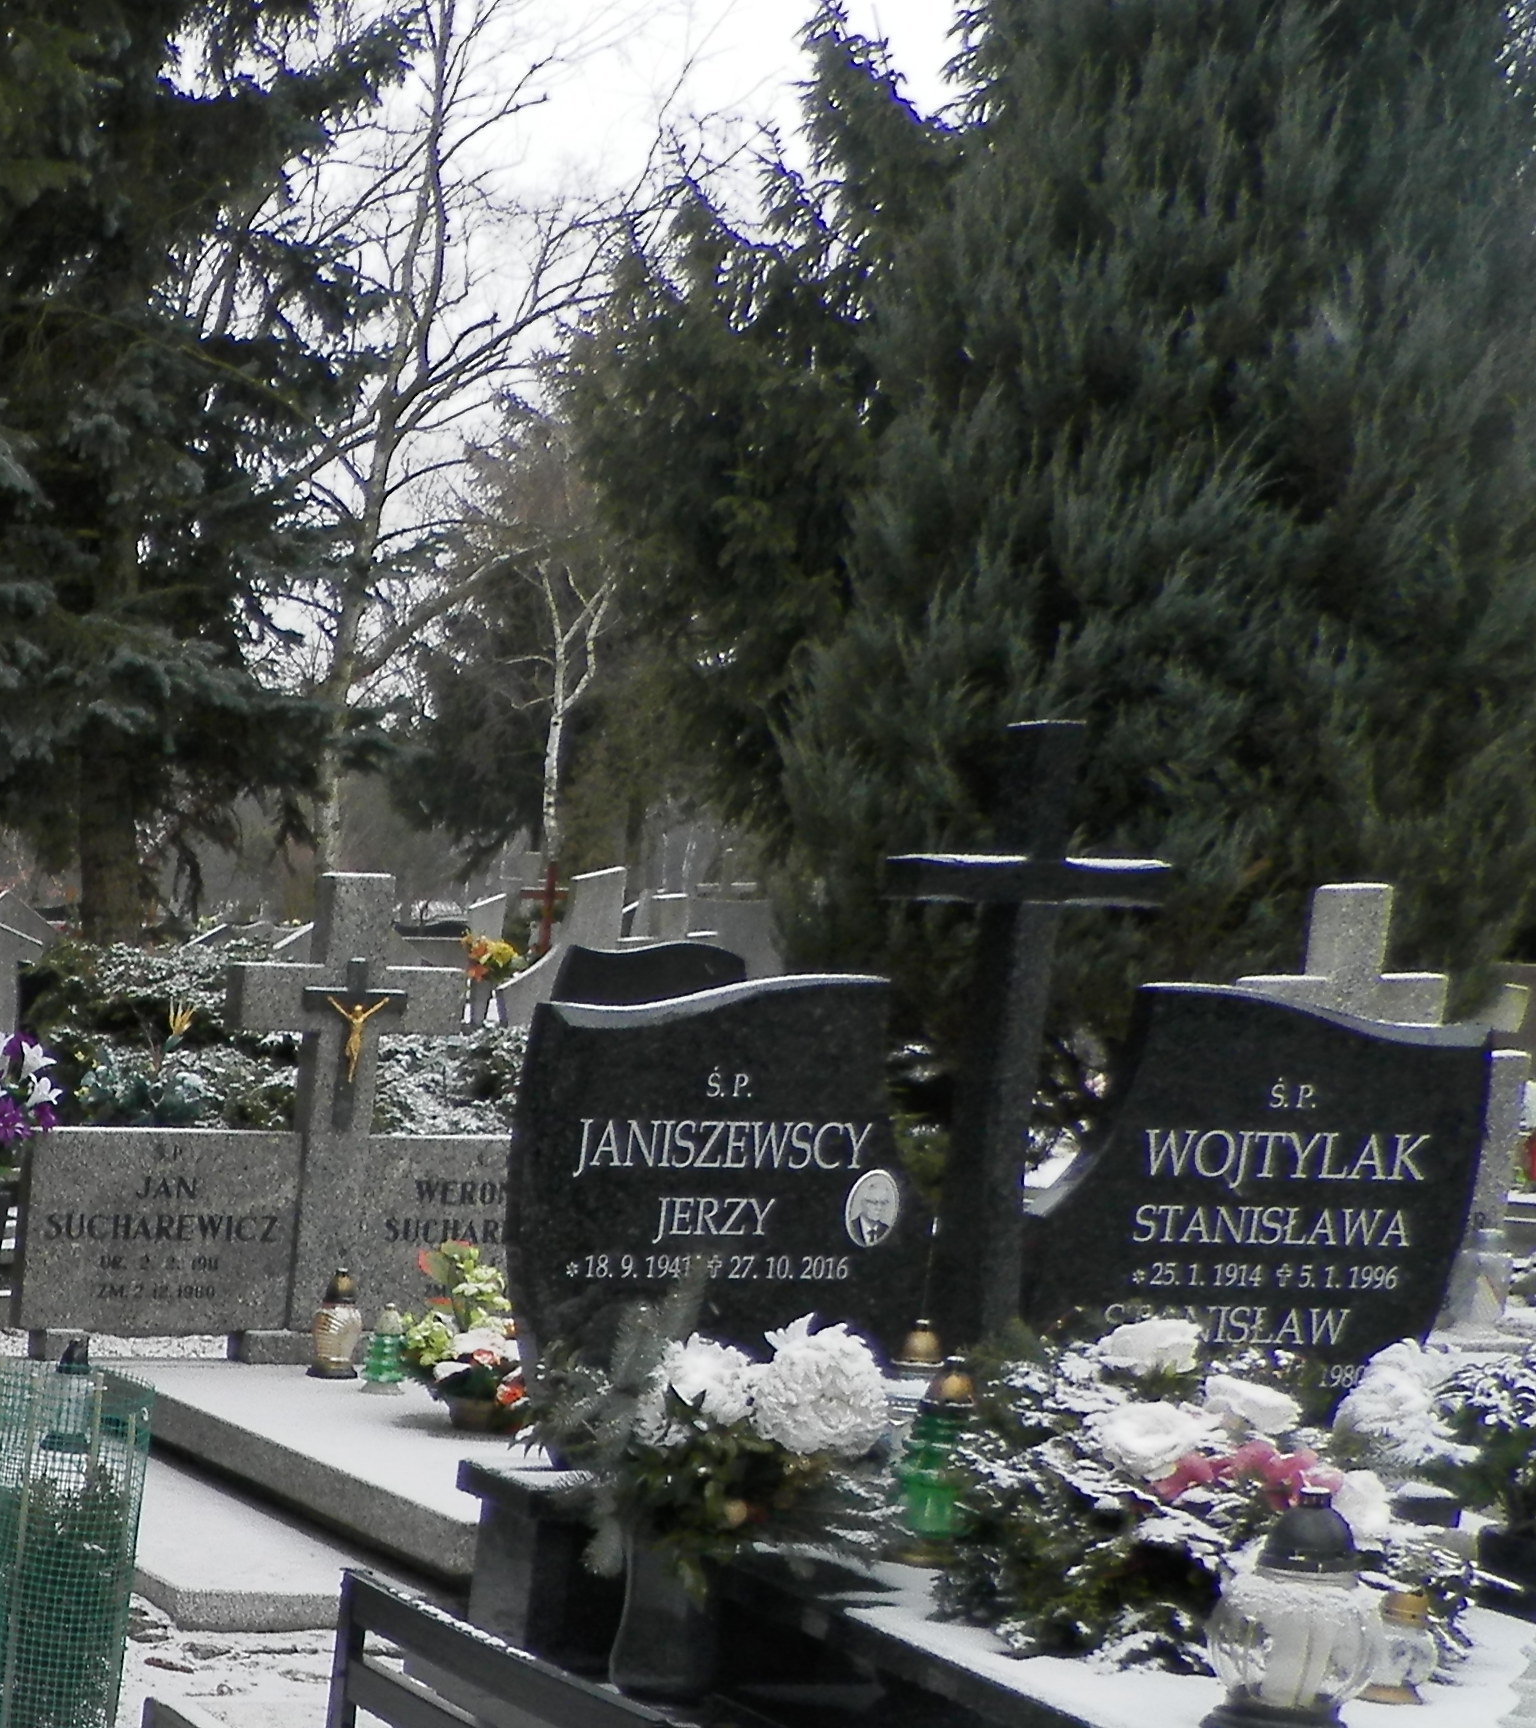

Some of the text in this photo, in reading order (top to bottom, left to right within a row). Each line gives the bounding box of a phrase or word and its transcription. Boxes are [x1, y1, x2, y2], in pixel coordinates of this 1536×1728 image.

[573, 1118, 873, 1178] JANISZEWSCY
[1145, 1128, 1431, 1191] WOJTYLAK
[135, 1176, 197, 1200] JAN
[44, 1212, 279, 1243] SUCHAREWICZ
[384, 1217, 505, 1244] SUCHAR
[652, 1197, 776, 1243] JERZY
[1132, 1204, 1411, 1247] STANISŁAWA
[800, 1256, 849, 1280] 2016
[1213, 1263, 1262, 1287] 1914
[1348, 1265, 1399, 1290] 1996
